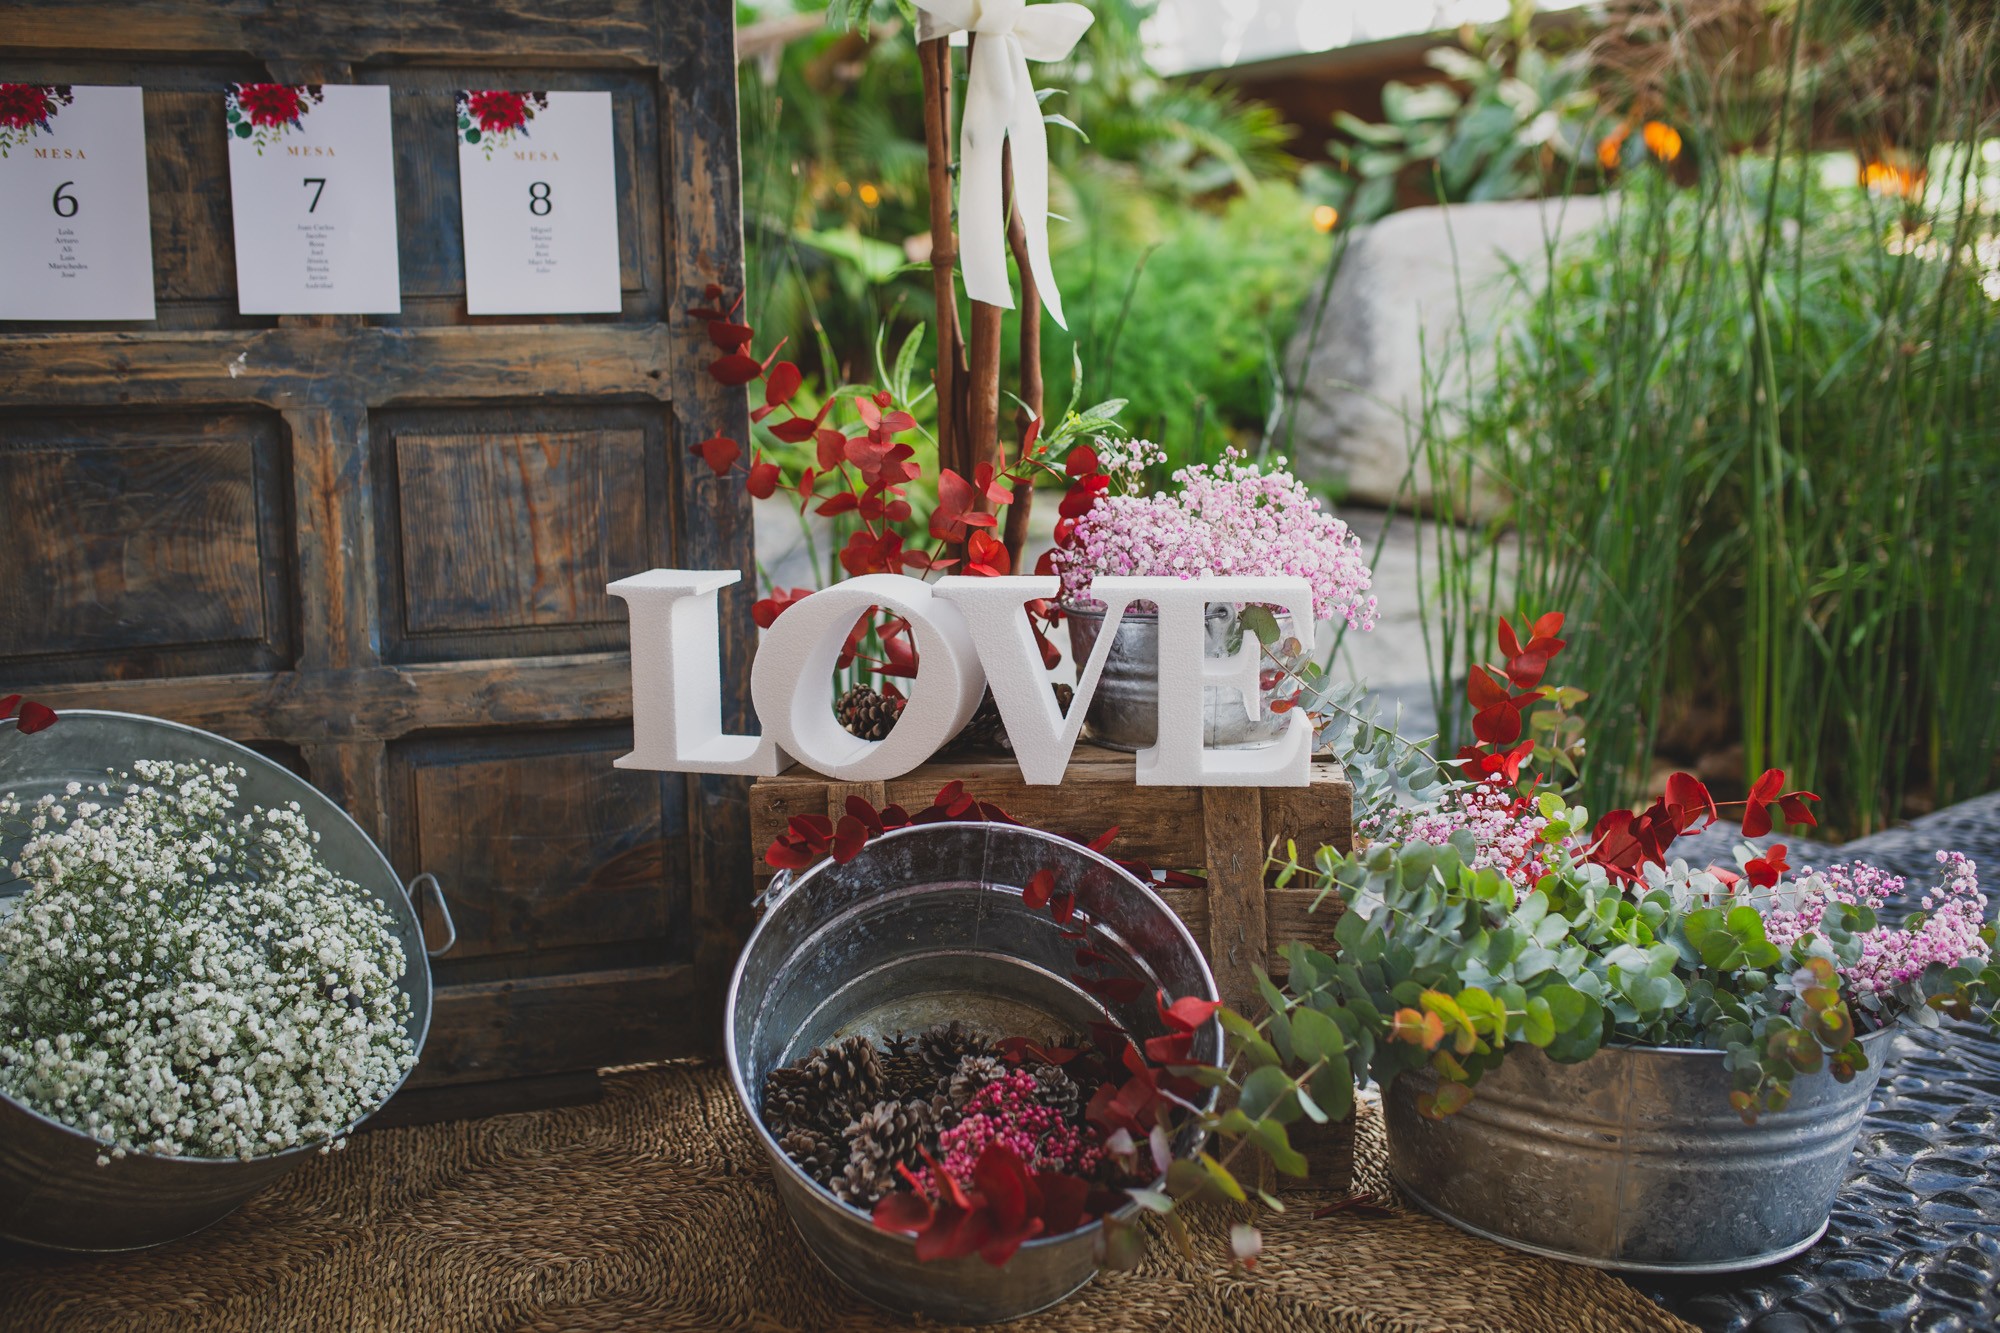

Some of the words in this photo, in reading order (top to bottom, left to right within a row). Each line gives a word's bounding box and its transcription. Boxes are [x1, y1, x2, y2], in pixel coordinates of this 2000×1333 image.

[34, 148, 86, 160] MESA
[287, 146, 336, 158] MESA
[514, 151, 560, 161] MESA
[53, 181, 79, 218] 6
[303, 178, 327, 214] 7
[528, 181, 553, 216] 8
[606, 568, 1314, 787] LOVE
